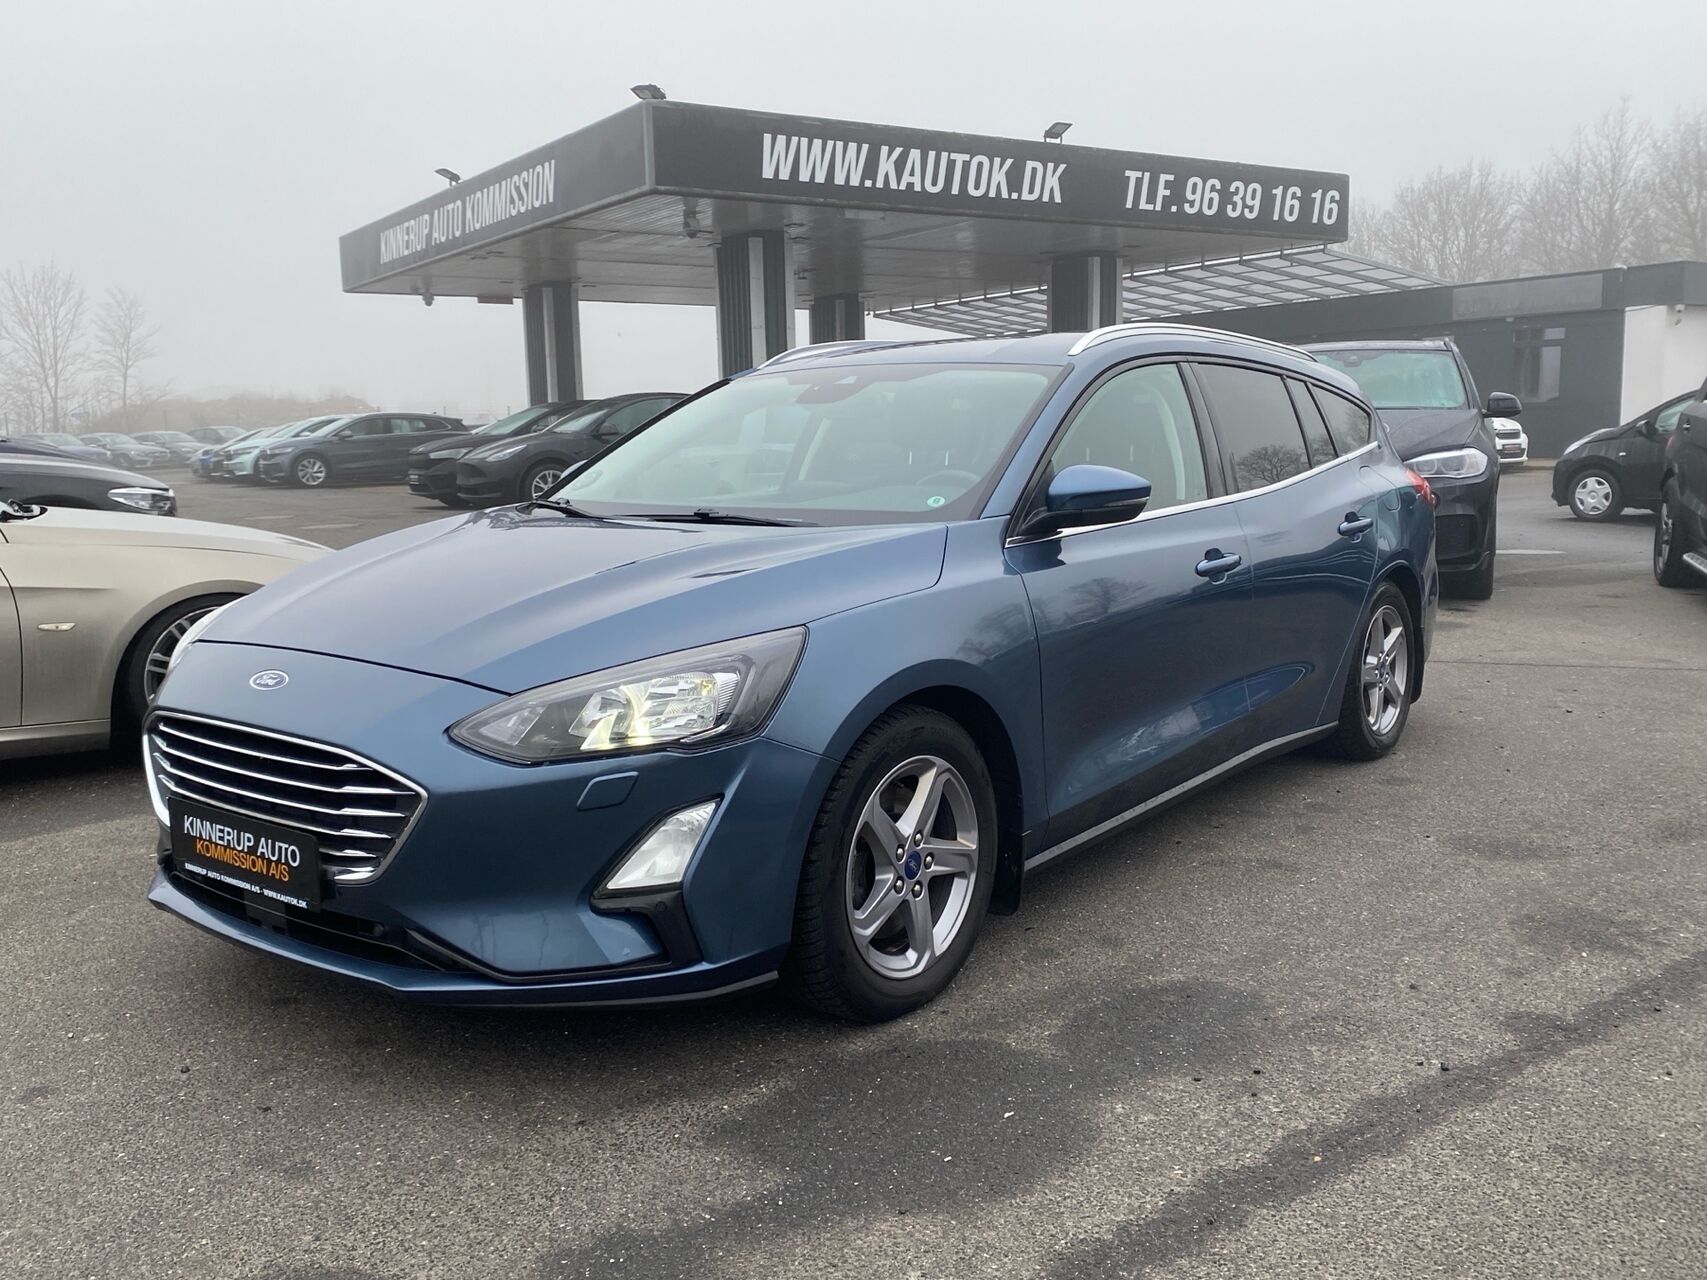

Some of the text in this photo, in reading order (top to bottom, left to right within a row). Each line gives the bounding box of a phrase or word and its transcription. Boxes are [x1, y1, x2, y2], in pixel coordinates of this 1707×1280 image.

[762, 133, 1067, 203] WWW.KAUTOK.DK
[380, 159, 555, 264] KINNERUP AUTO KOMMISSION
[1125, 170, 1340, 225] TLF. 96 39 16 16
[184, 815, 300, 867] KINNERUP AUTO
[196, 839, 289, 882] KOMMISSION A/S
